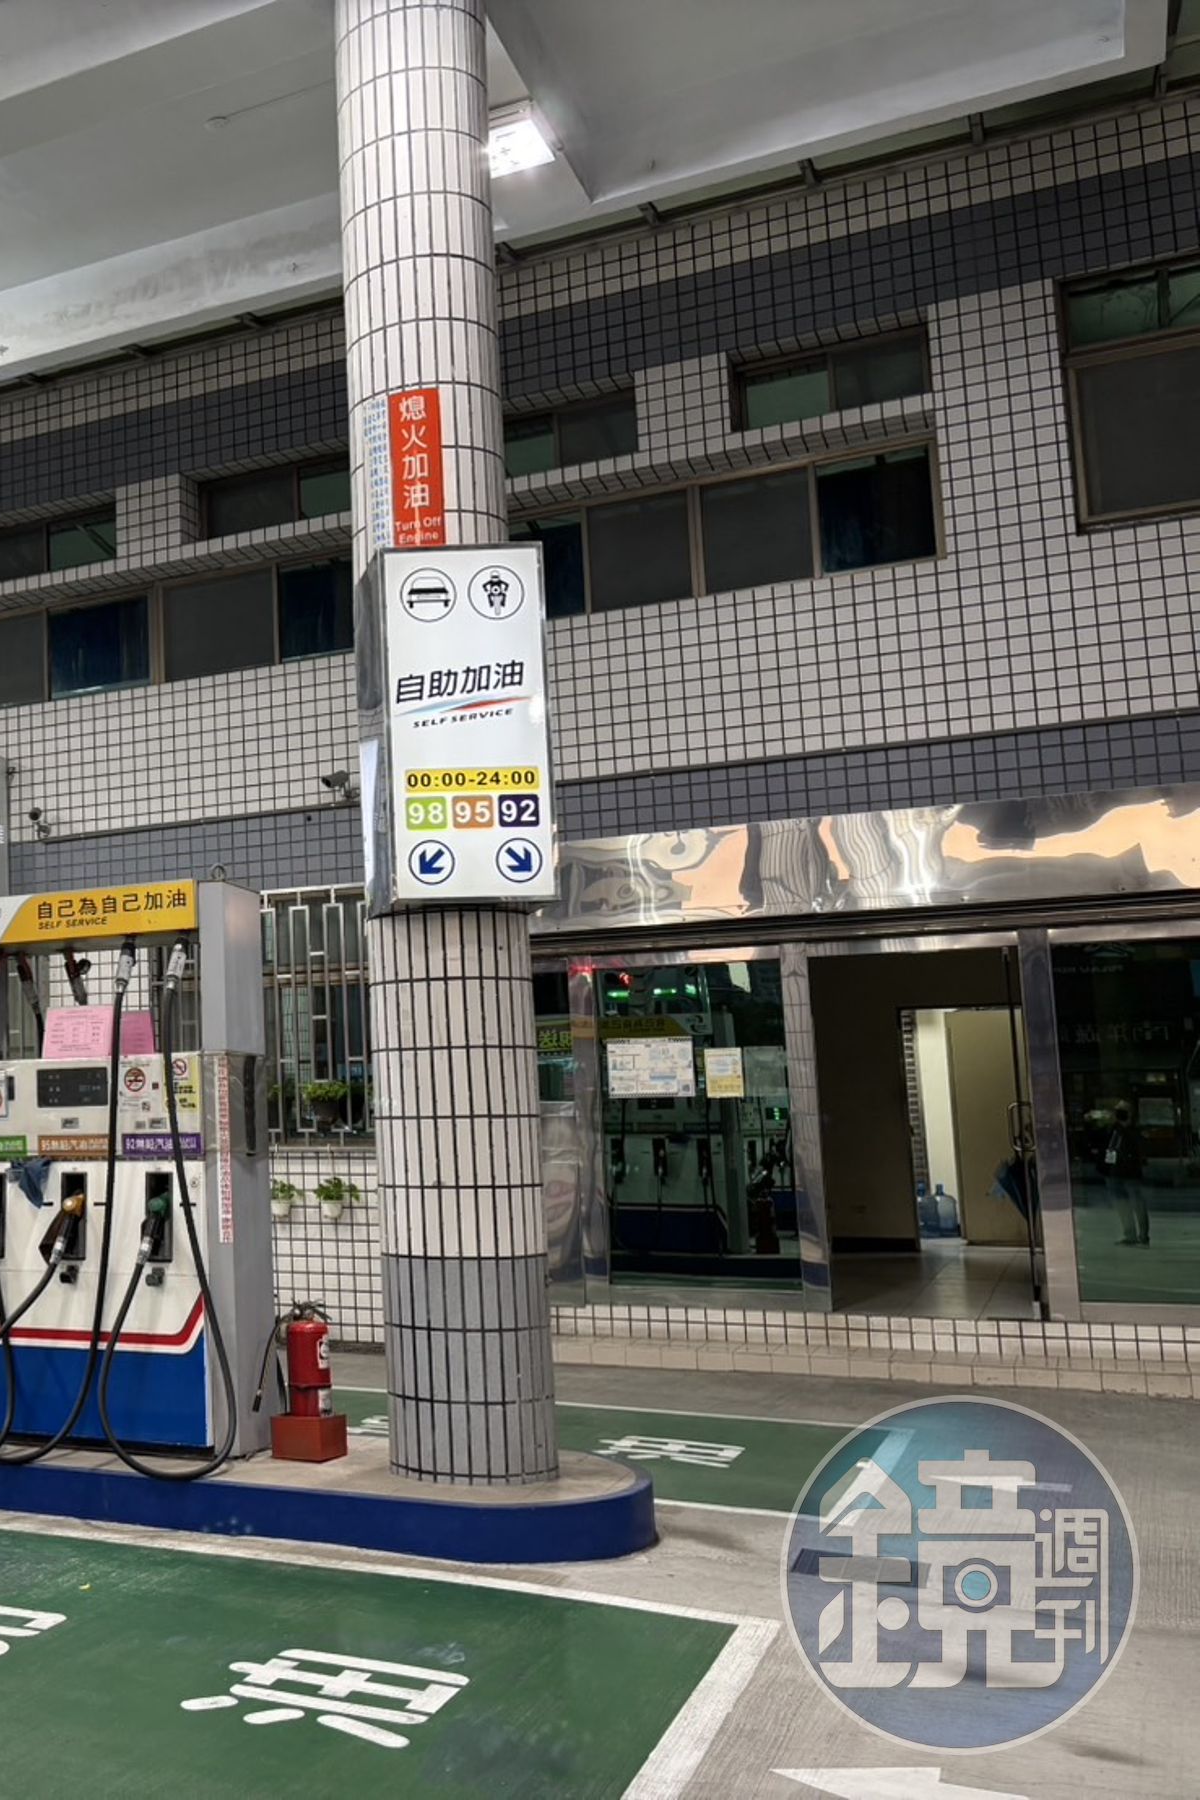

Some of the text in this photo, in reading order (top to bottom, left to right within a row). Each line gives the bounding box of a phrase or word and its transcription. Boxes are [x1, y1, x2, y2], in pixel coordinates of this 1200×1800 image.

[399, 395, 430, 510] 熄火加油
[423, 516, 441, 528] Off
[396, 659, 524, 704] 自助加油
[412, 708, 513, 728] SELF SERVICE
[407, 770, 535, 788] 00:00-24:00
[407, 799, 536, 825] 98 95 92
[37, 888, 187, 920] 自己為自己加油
[38, 916, 108, 930] SELF SERVICE
